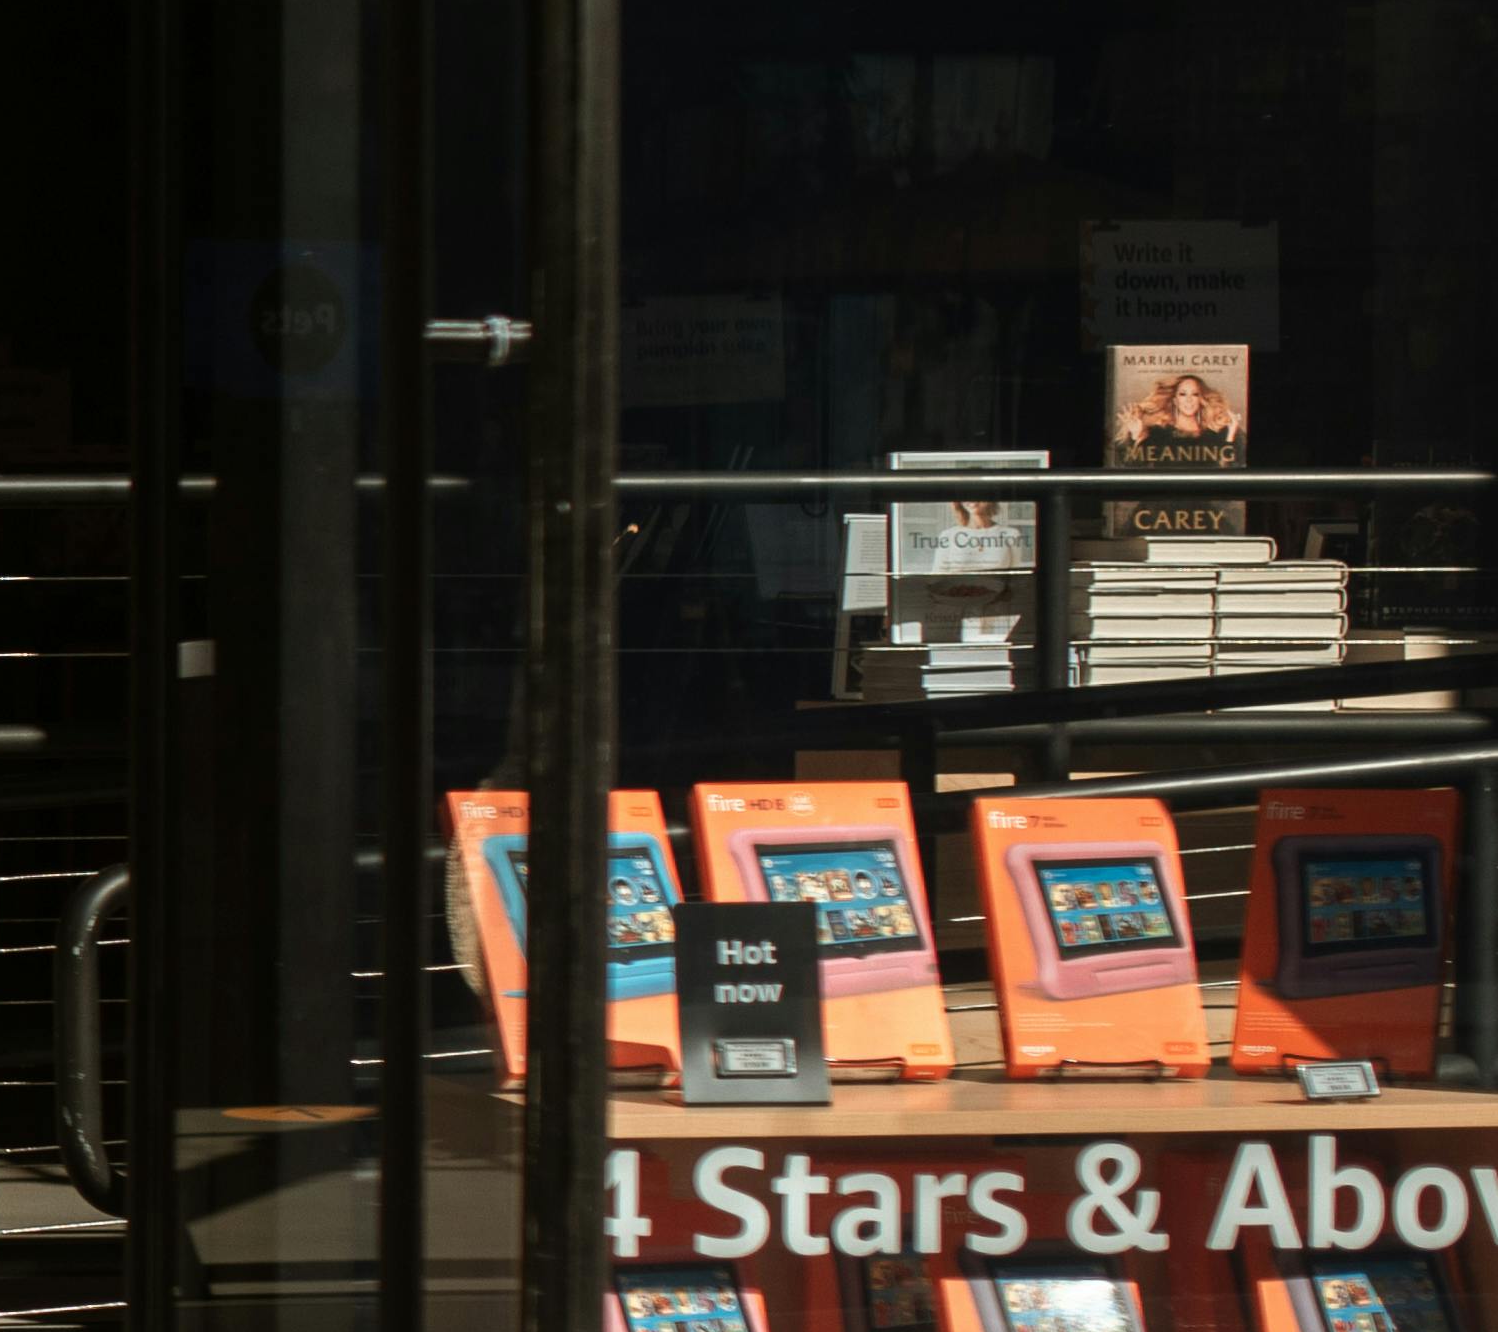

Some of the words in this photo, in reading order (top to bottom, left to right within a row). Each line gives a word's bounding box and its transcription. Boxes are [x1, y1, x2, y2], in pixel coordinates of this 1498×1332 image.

[1114, 243, 1172, 263] Write
[1179, 242, 1194, 263] it
[1115, 269, 1180, 291] down,
[1187, 269, 1245, 290] make
[1115, 297, 1131, 317] it
[1137, 297, 1217, 323] happen
[1124, 354, 1185, 366] MARIAH
[1192, 354, 1238, 366] CAREY
[1123, 443, 1236, 463] MEANING
[1134, 510, 1225, 531] CAREY
[909, 532, 949, 549] True
[954, 531, 1031, 549] Comfort
[716, 940, 777, 965] Hot
[715, 982, 783, 1004] now
[691, 1144, 1029, 1257] Stars
[1065, 1139, 1171, 1255] &
